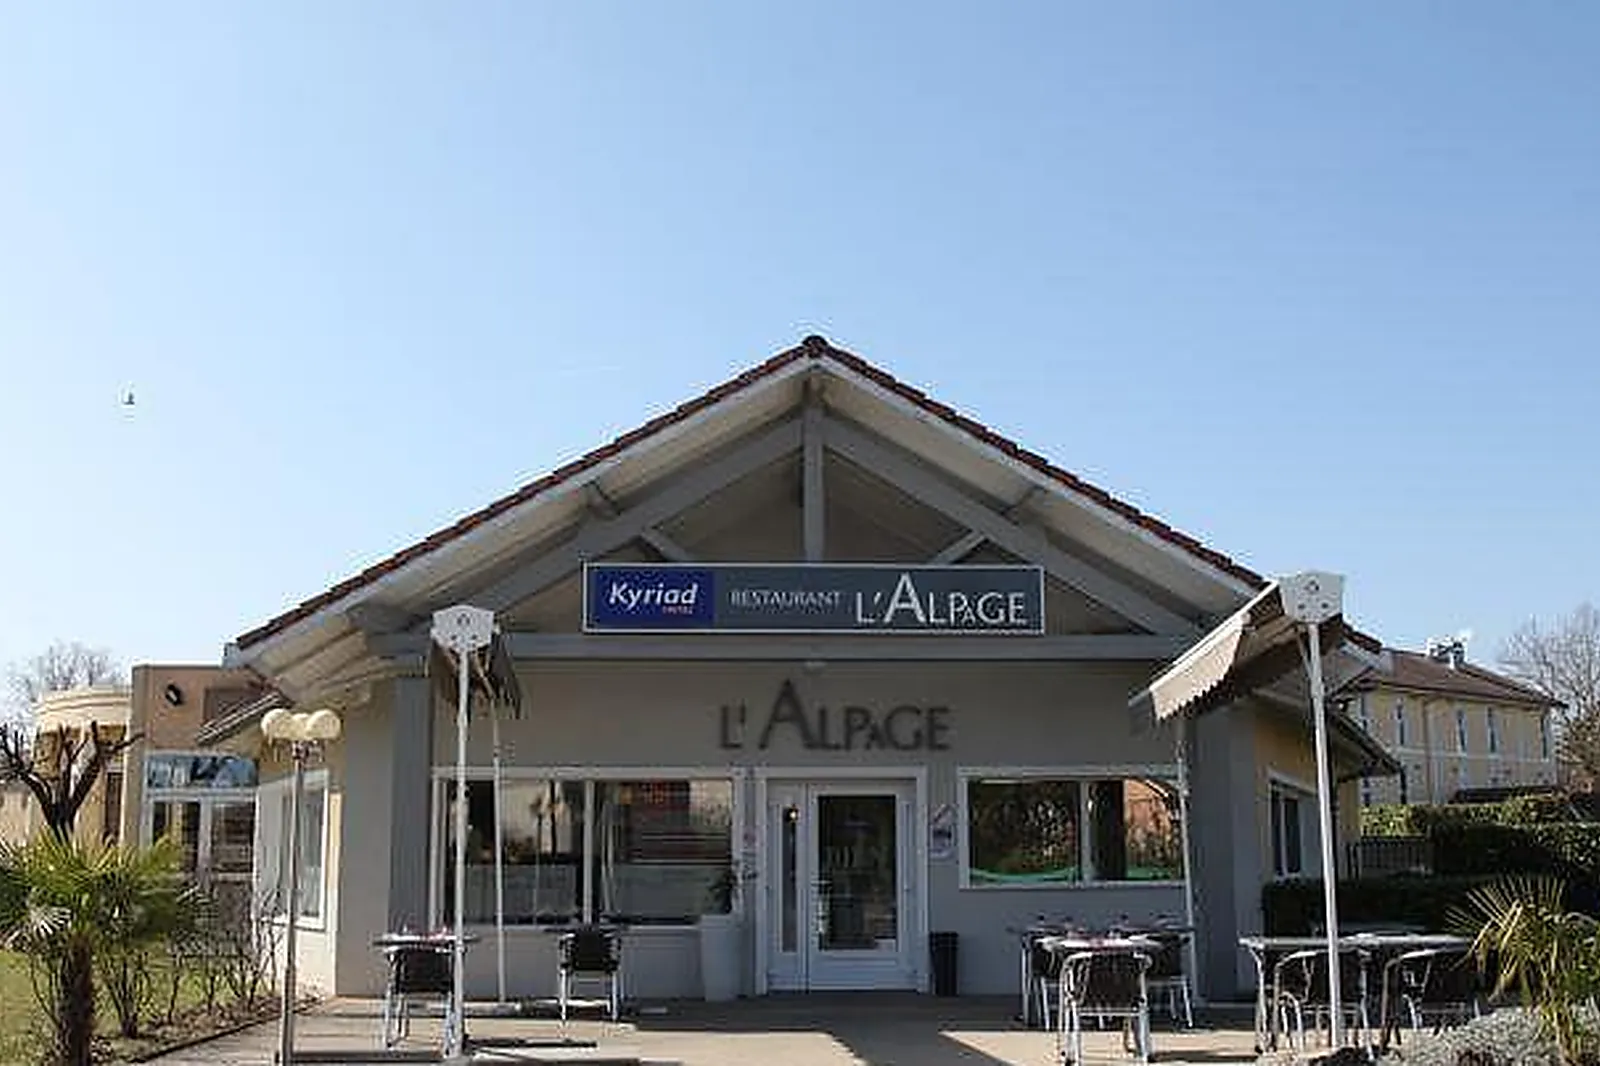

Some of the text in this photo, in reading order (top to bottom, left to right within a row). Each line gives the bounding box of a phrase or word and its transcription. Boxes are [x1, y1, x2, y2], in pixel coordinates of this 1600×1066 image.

[609, 582, 698, 610] Kyriad
[731, 571, 1028, 624] RESTAURANT L'ALPAGE
[720, 678, 951, 751] L'ALPAGE
